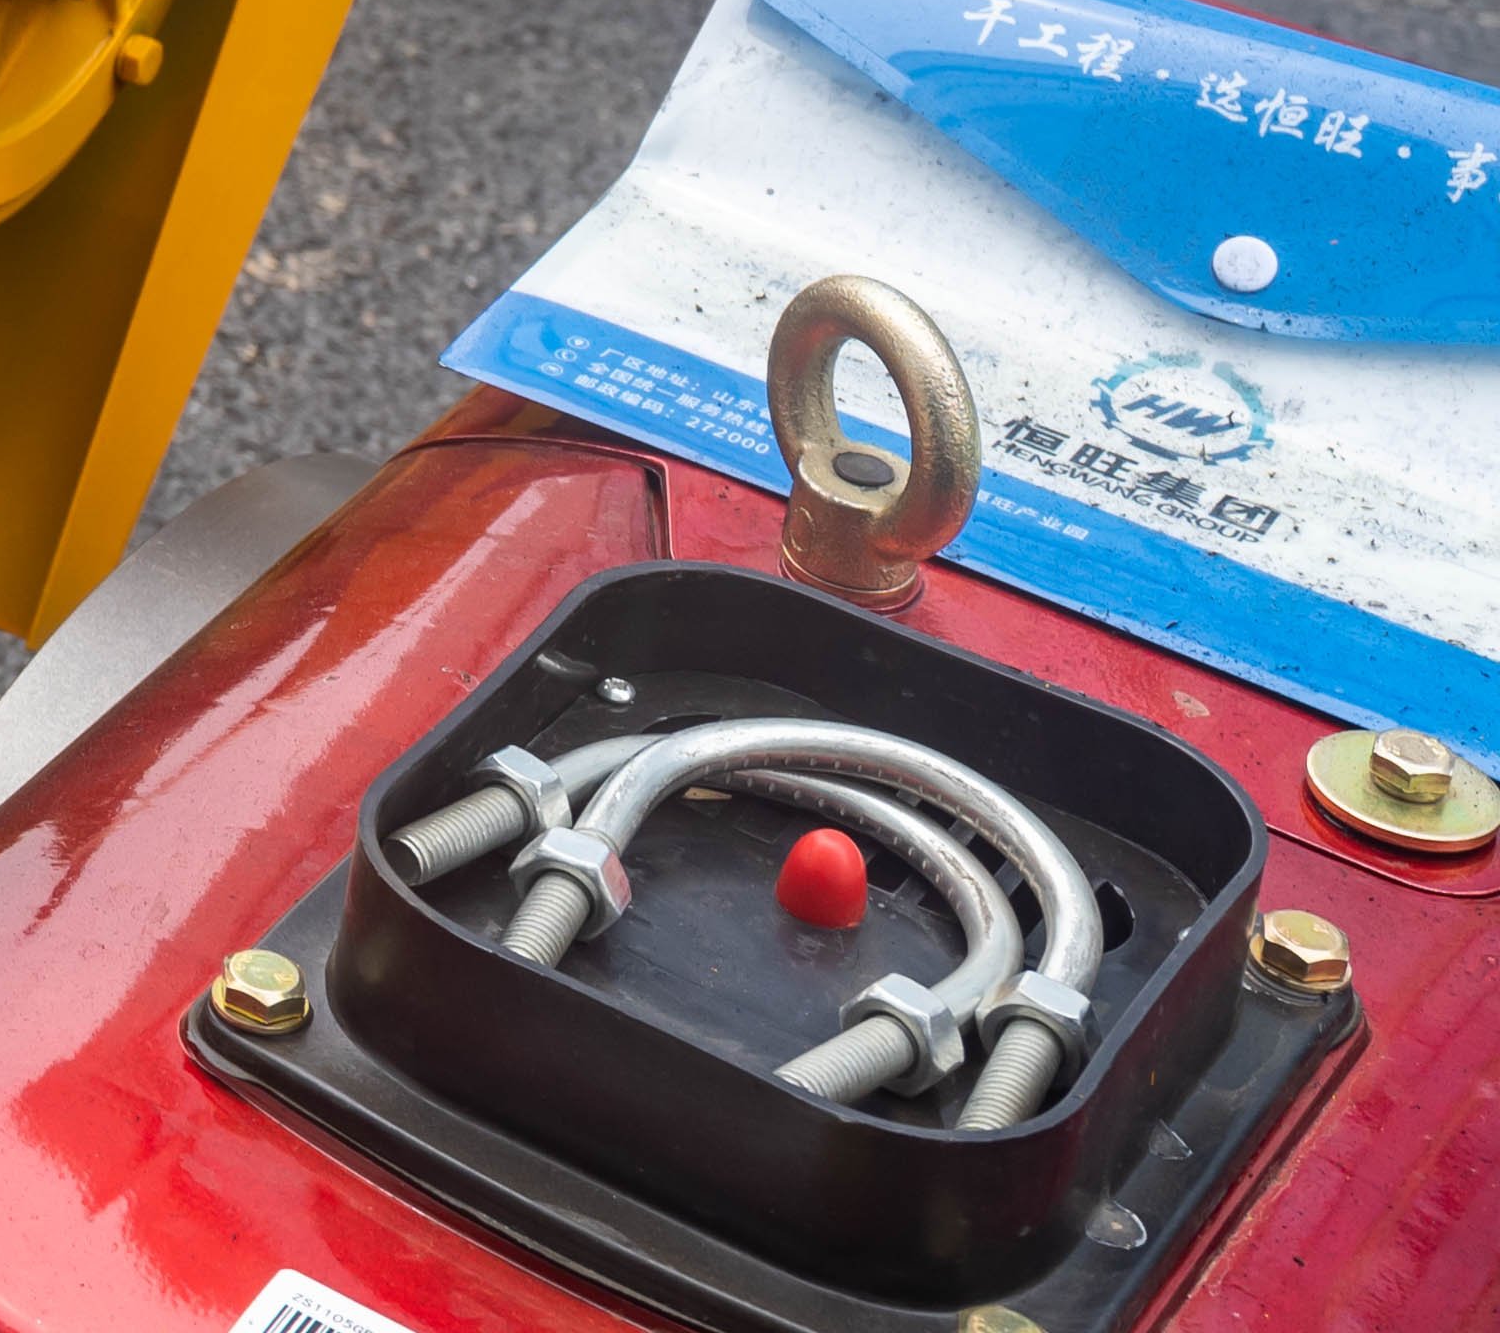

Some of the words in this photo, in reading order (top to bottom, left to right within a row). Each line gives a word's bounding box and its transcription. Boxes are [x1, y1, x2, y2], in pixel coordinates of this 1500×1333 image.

[1121, 393, 1245, 437] HW
[991, 440, 1154, 507] HENGWANG
[1155, 502, 1261, 543] GROUP
[1003, 416, 1281, 535] 恒旺集团
